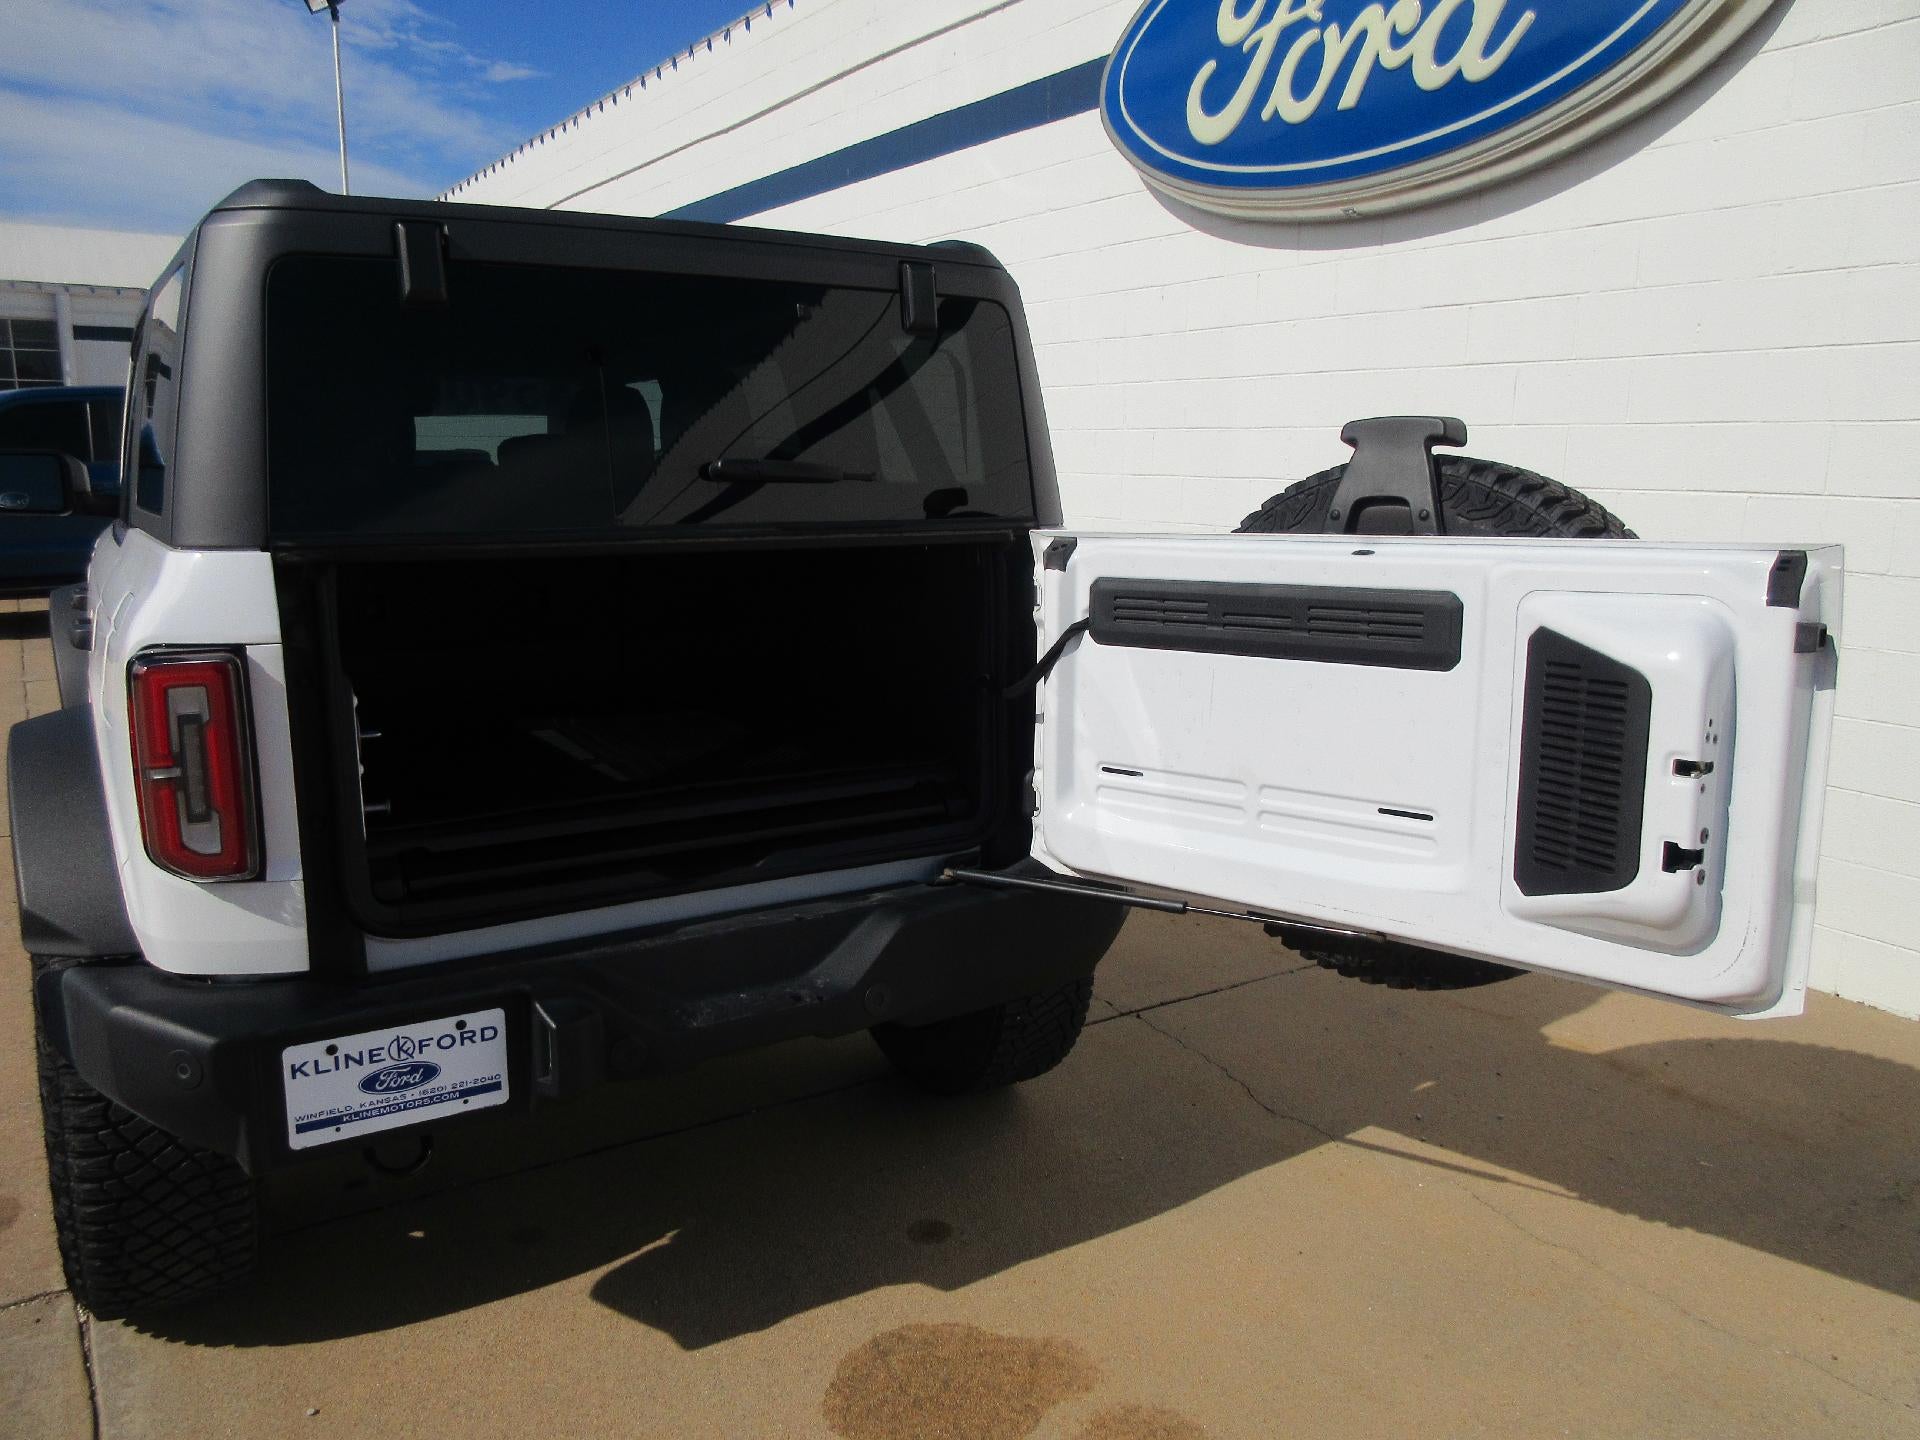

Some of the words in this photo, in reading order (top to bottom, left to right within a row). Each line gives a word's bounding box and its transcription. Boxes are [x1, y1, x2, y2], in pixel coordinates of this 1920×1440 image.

[1186, 0, 1535, 146] Ford
[290, 1046, 386, 1080] KLINE
[418, 1025, 498, 1055] FORD
[360, 1093, 407, 1109] KANSAS
[451, 1073, 501, 1089] 221-2040
[375, 1066, 424, 1091] Ford
[343, 1091, 460, 1122] KLINEMOTORS.COM
